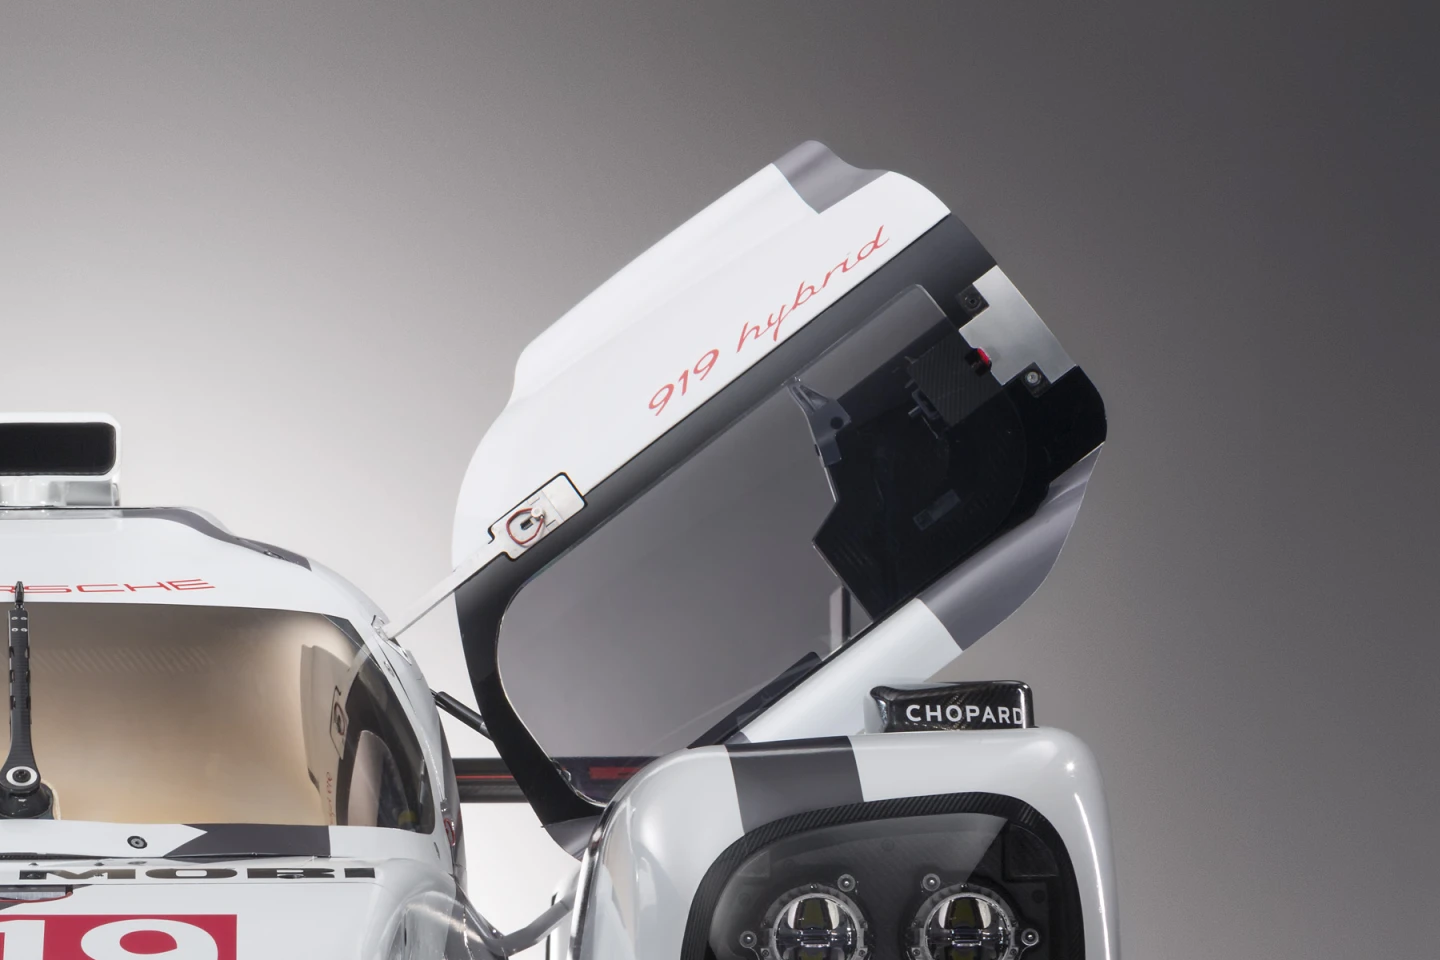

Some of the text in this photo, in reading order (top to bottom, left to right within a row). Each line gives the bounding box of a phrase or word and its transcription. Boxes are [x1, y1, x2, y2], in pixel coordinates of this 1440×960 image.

[648, 225, 890, 417] 919 hybrid
[905, 704, 1024, 726] CHOPARD
[18, 867, 376, 880] MORI
